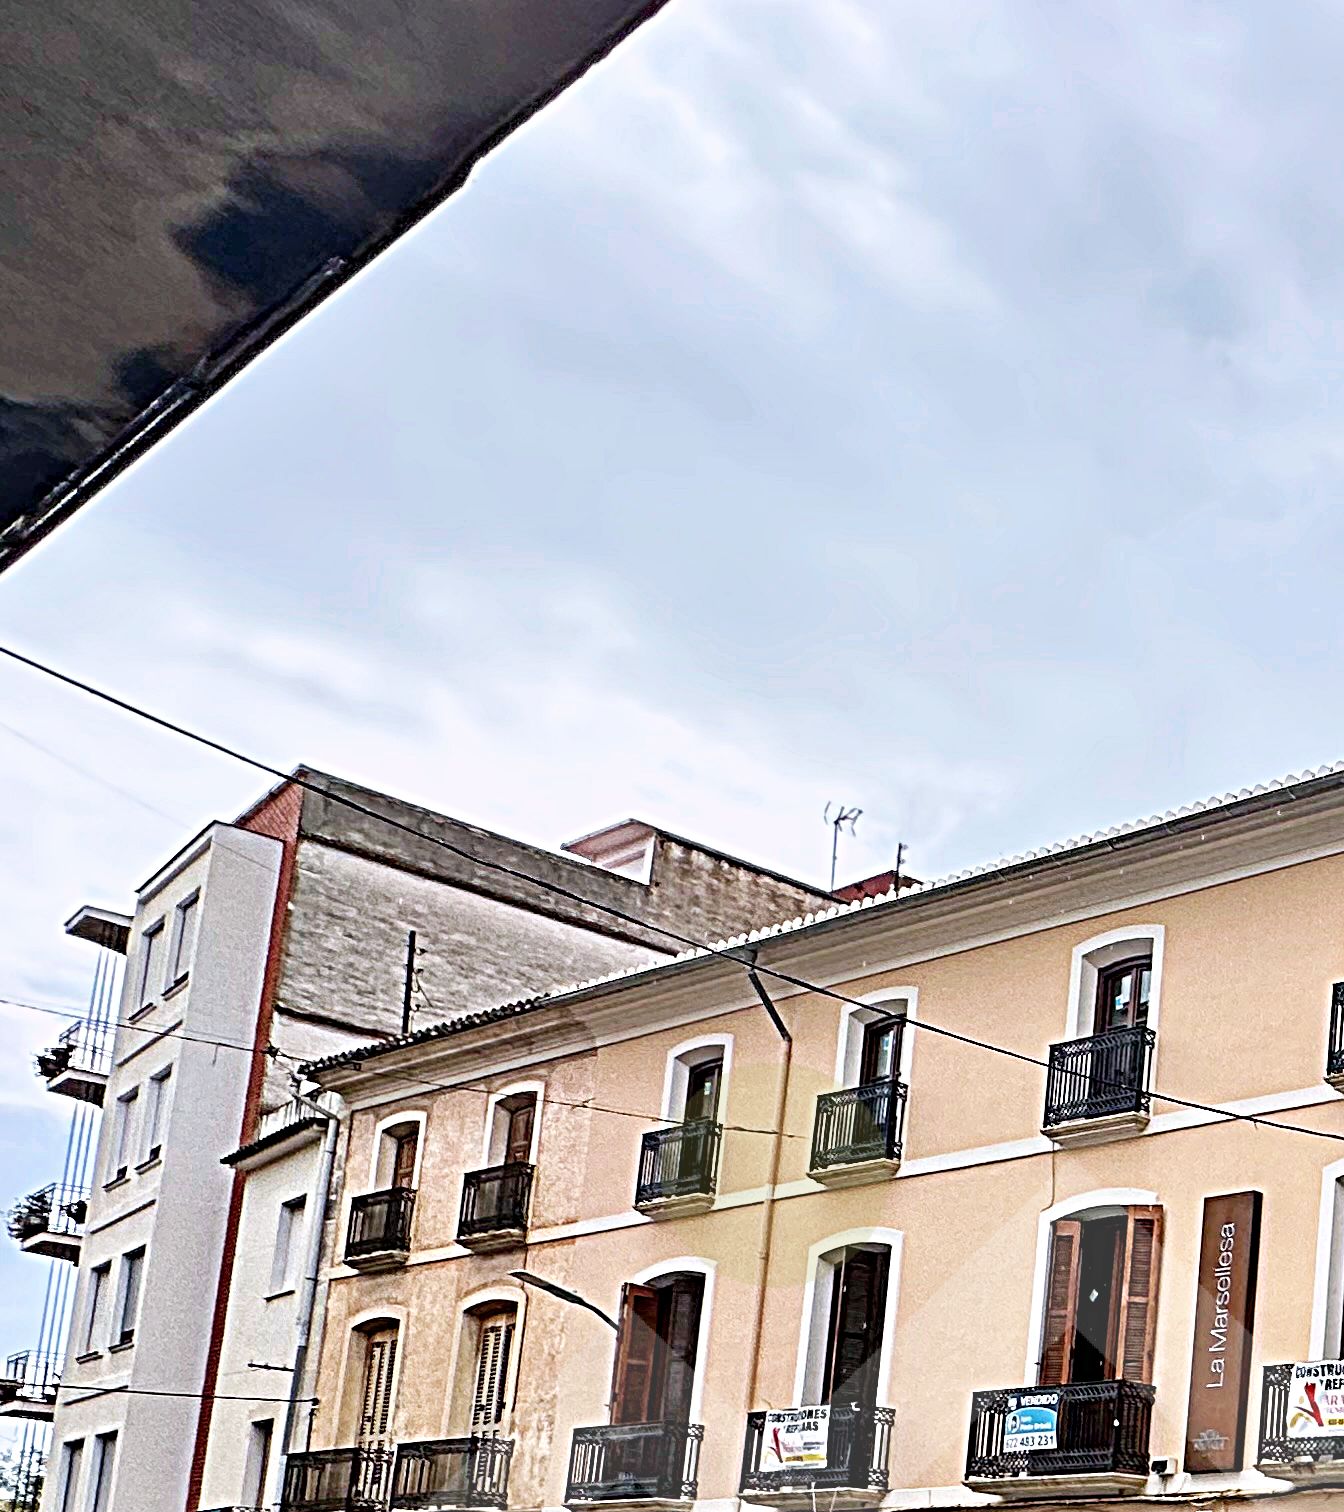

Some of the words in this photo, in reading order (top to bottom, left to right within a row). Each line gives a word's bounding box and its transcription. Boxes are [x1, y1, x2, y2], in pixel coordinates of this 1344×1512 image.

[1208, 1222, 1236, 1353] Marsellesa
[1206, 1357, 1225, 1389] La
[1021, 1393, 1058, 1406] VENDIDO
